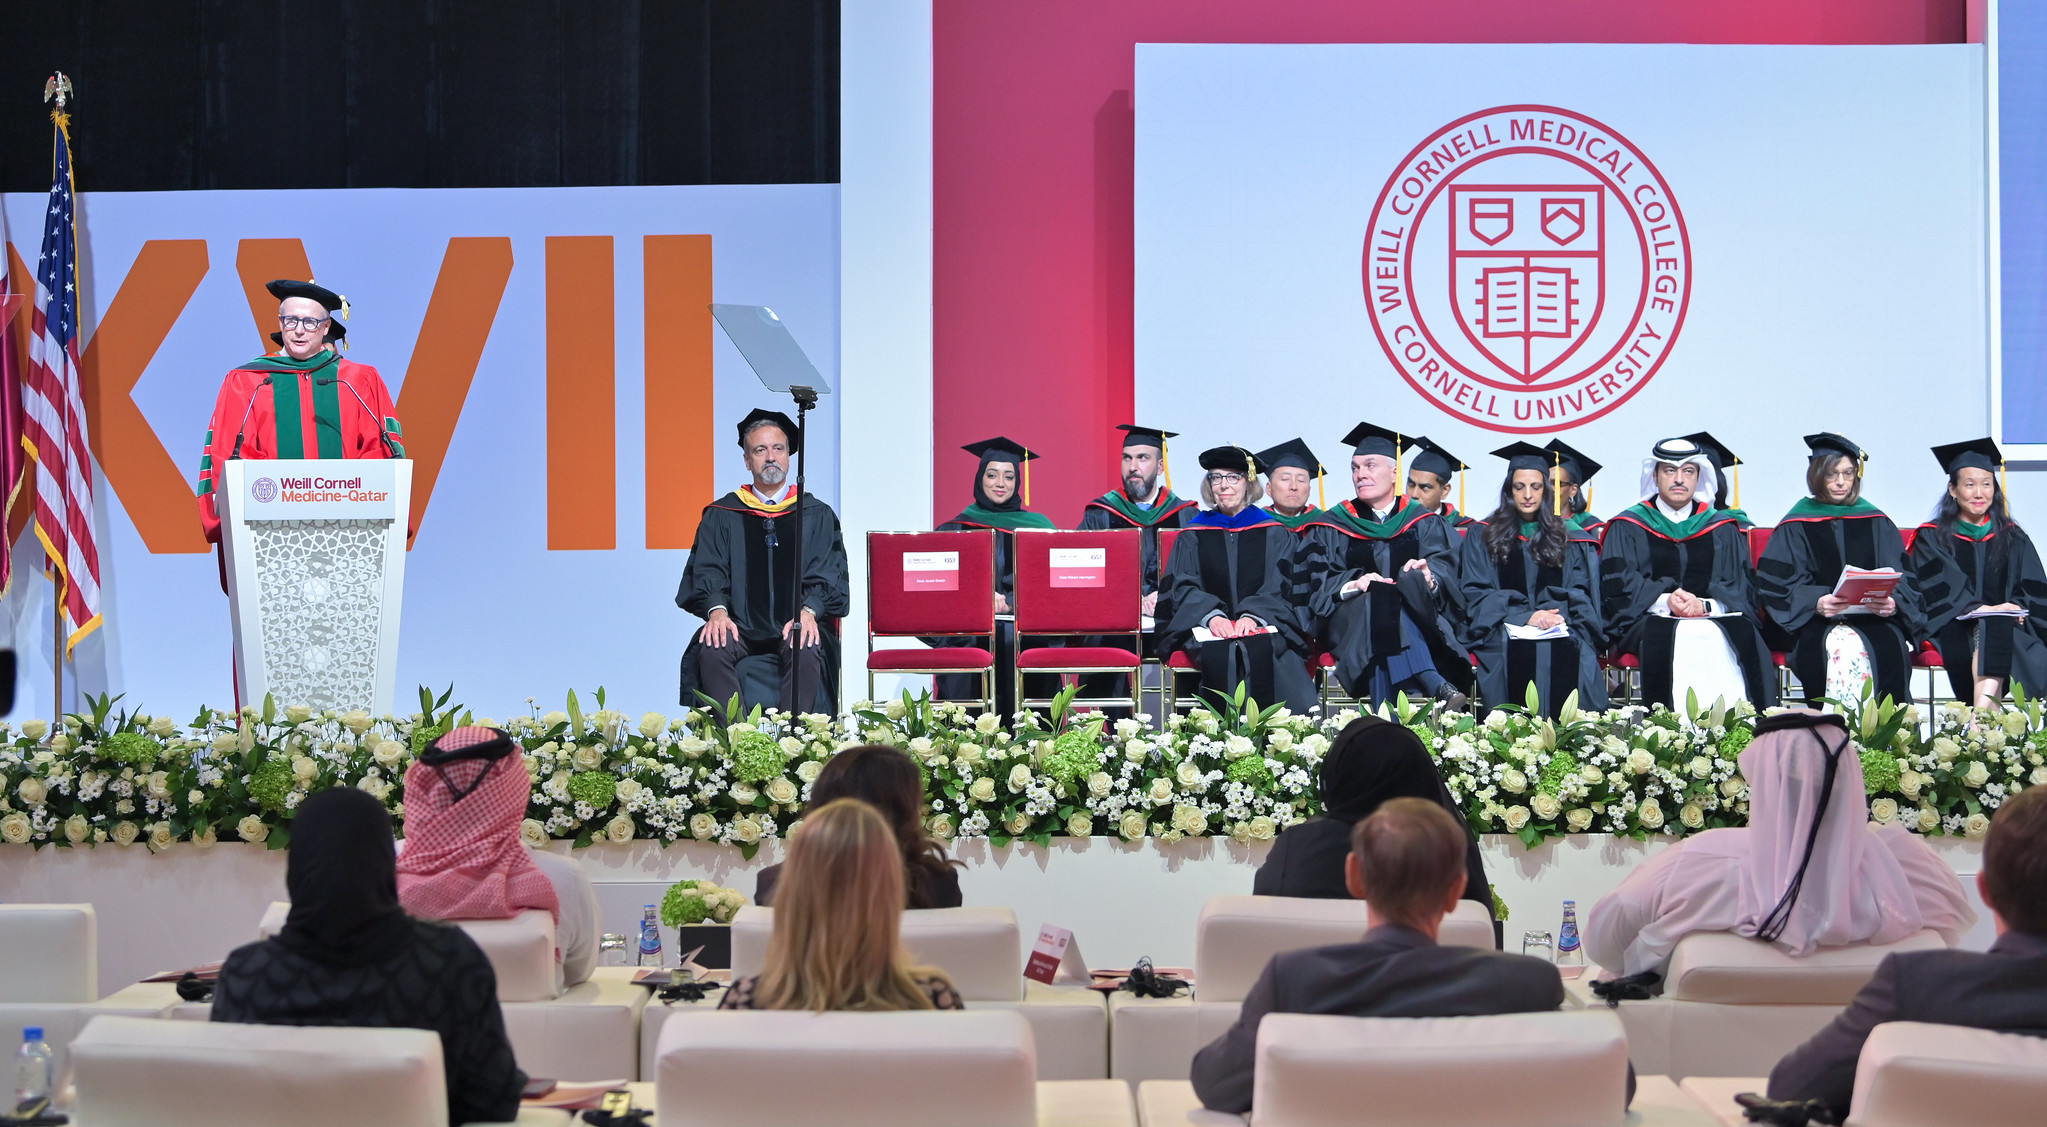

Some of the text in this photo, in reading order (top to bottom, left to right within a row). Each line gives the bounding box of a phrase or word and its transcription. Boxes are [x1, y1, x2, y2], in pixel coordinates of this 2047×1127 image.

[1376, 118, 1679, 314] WEILL CORNELL MEDICAL COLLEGE
[1394, 322, 1663, 421] CORNELL UNIVERSITY
[280, 477, 362, 490] Weill Cornell
[281, 490, 389, 502] Medicine-Qatar
